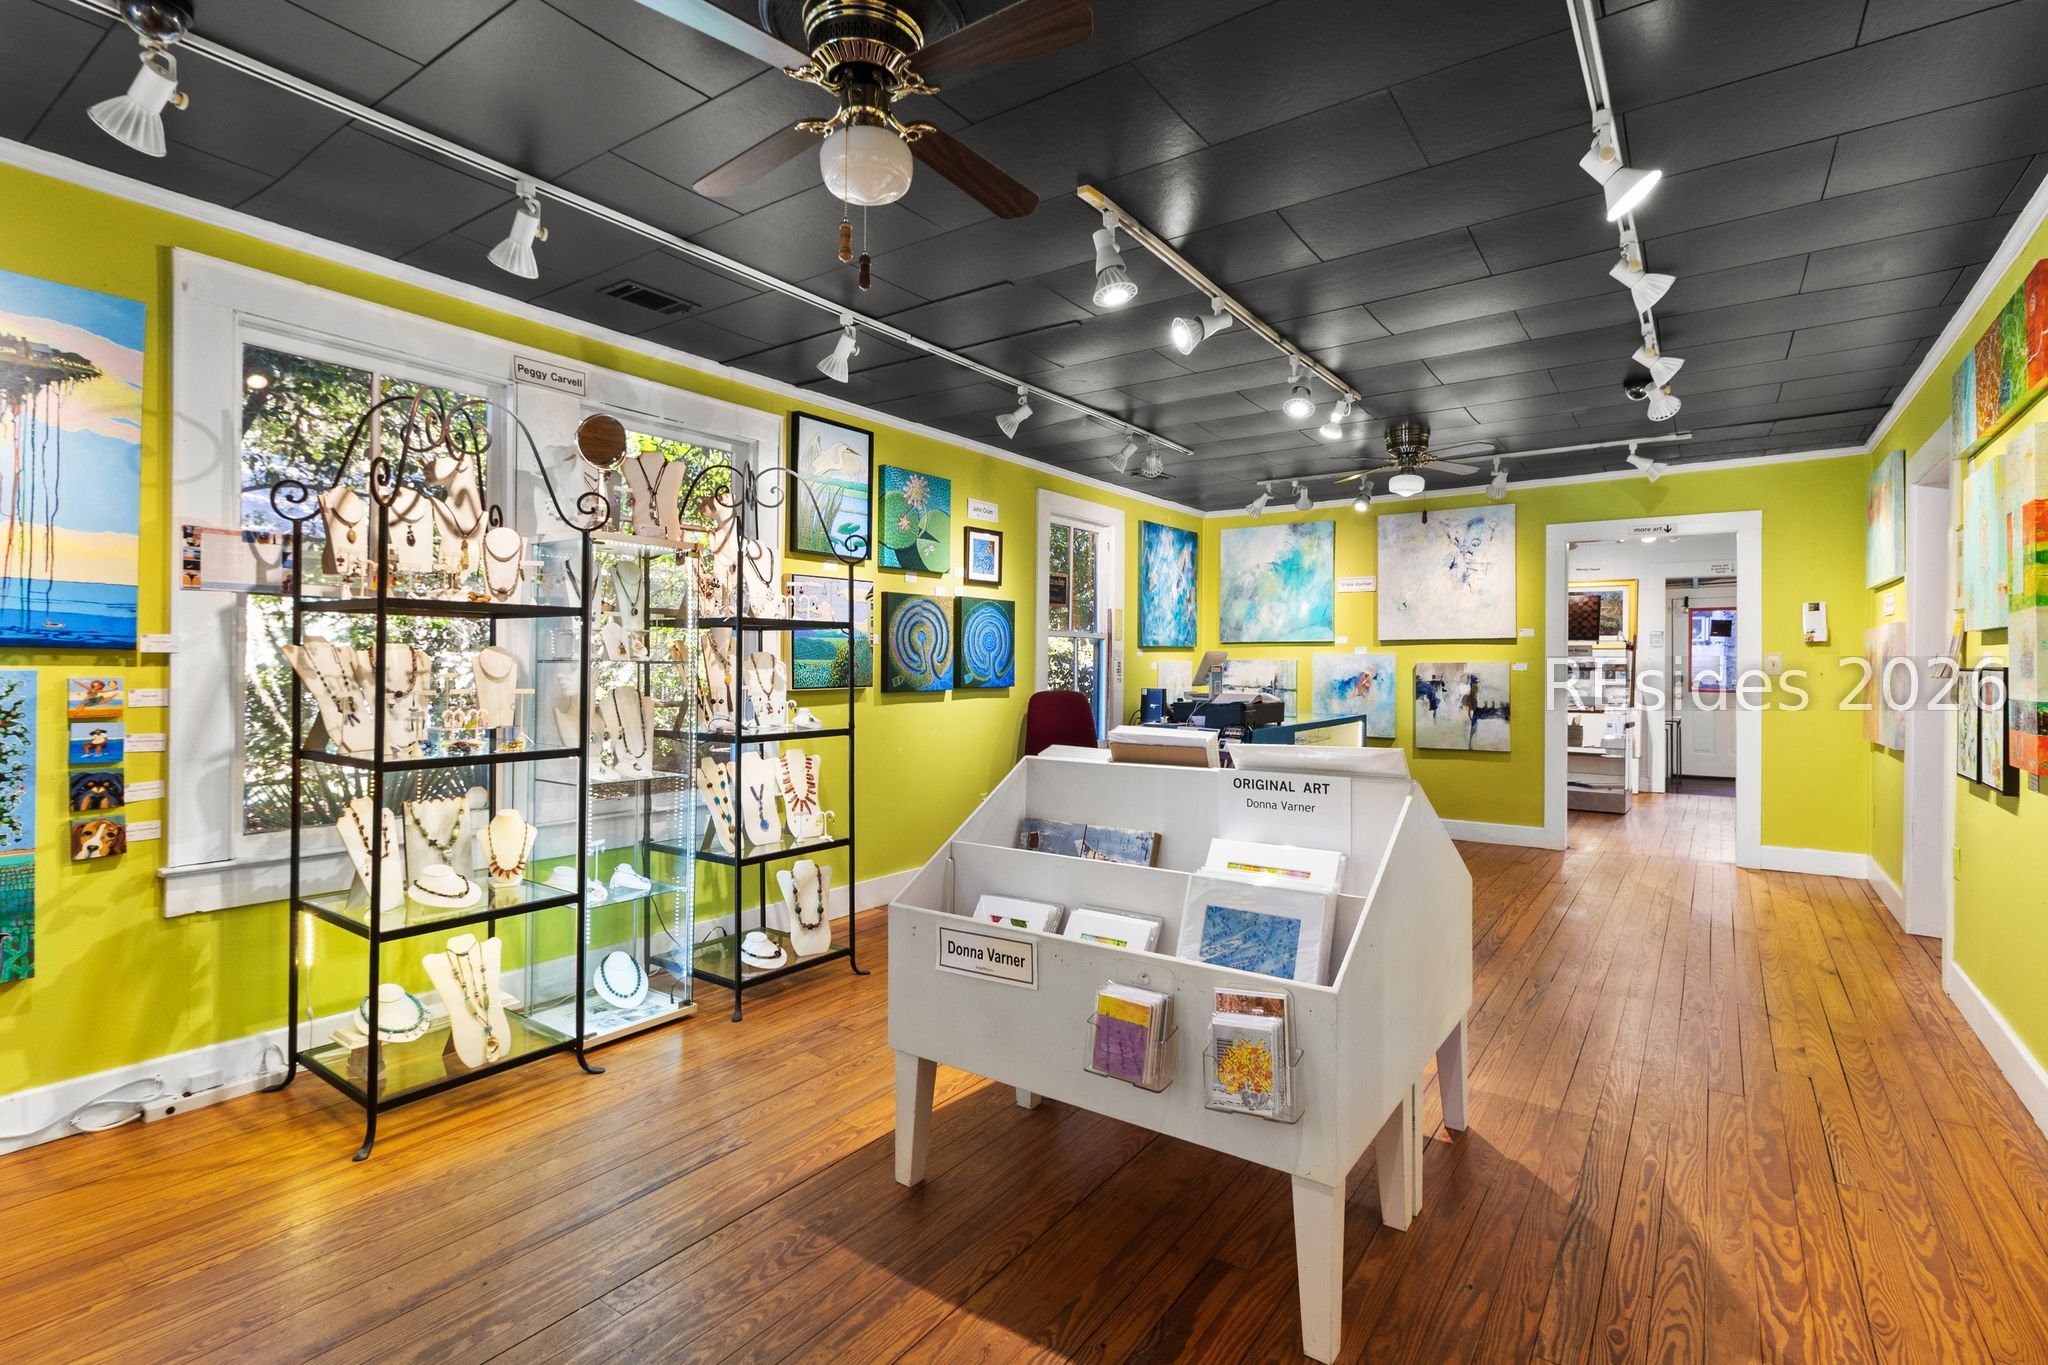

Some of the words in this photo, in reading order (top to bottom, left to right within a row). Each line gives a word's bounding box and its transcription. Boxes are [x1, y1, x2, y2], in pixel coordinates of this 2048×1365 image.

[517, 363, 547, 380] Peggy
[550, 372, 582, 387] Carvell
[1233, 777, 1296, 793] ORIGINAL
[1303, 782, 1330, 795] ART
[1246, 798, 1278, 810] Donna
[1280, 800, 1316, 813] Varner
[947, 940, 984, 960] Donna
[987, 947, 1026, 968] Varner
